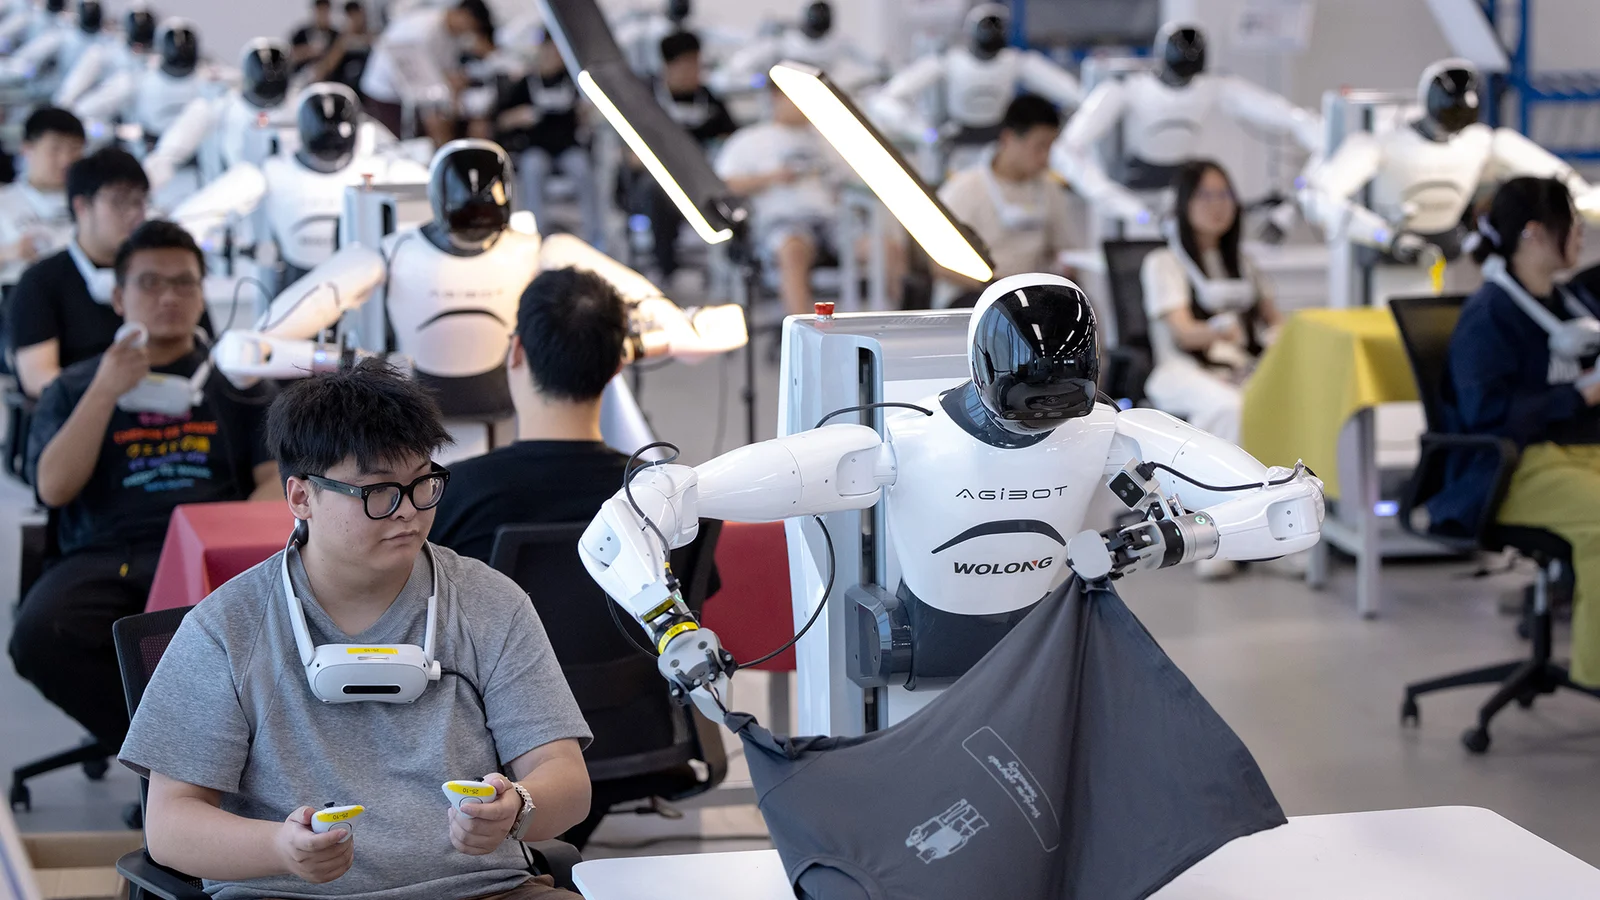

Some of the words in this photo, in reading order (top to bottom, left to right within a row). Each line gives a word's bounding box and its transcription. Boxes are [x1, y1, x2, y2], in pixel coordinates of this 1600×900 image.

[953, 556, 1053, 575] WOLONG
[462, 787, 479, 795] 25-10
[332, 812, 349, 820] 25-10
